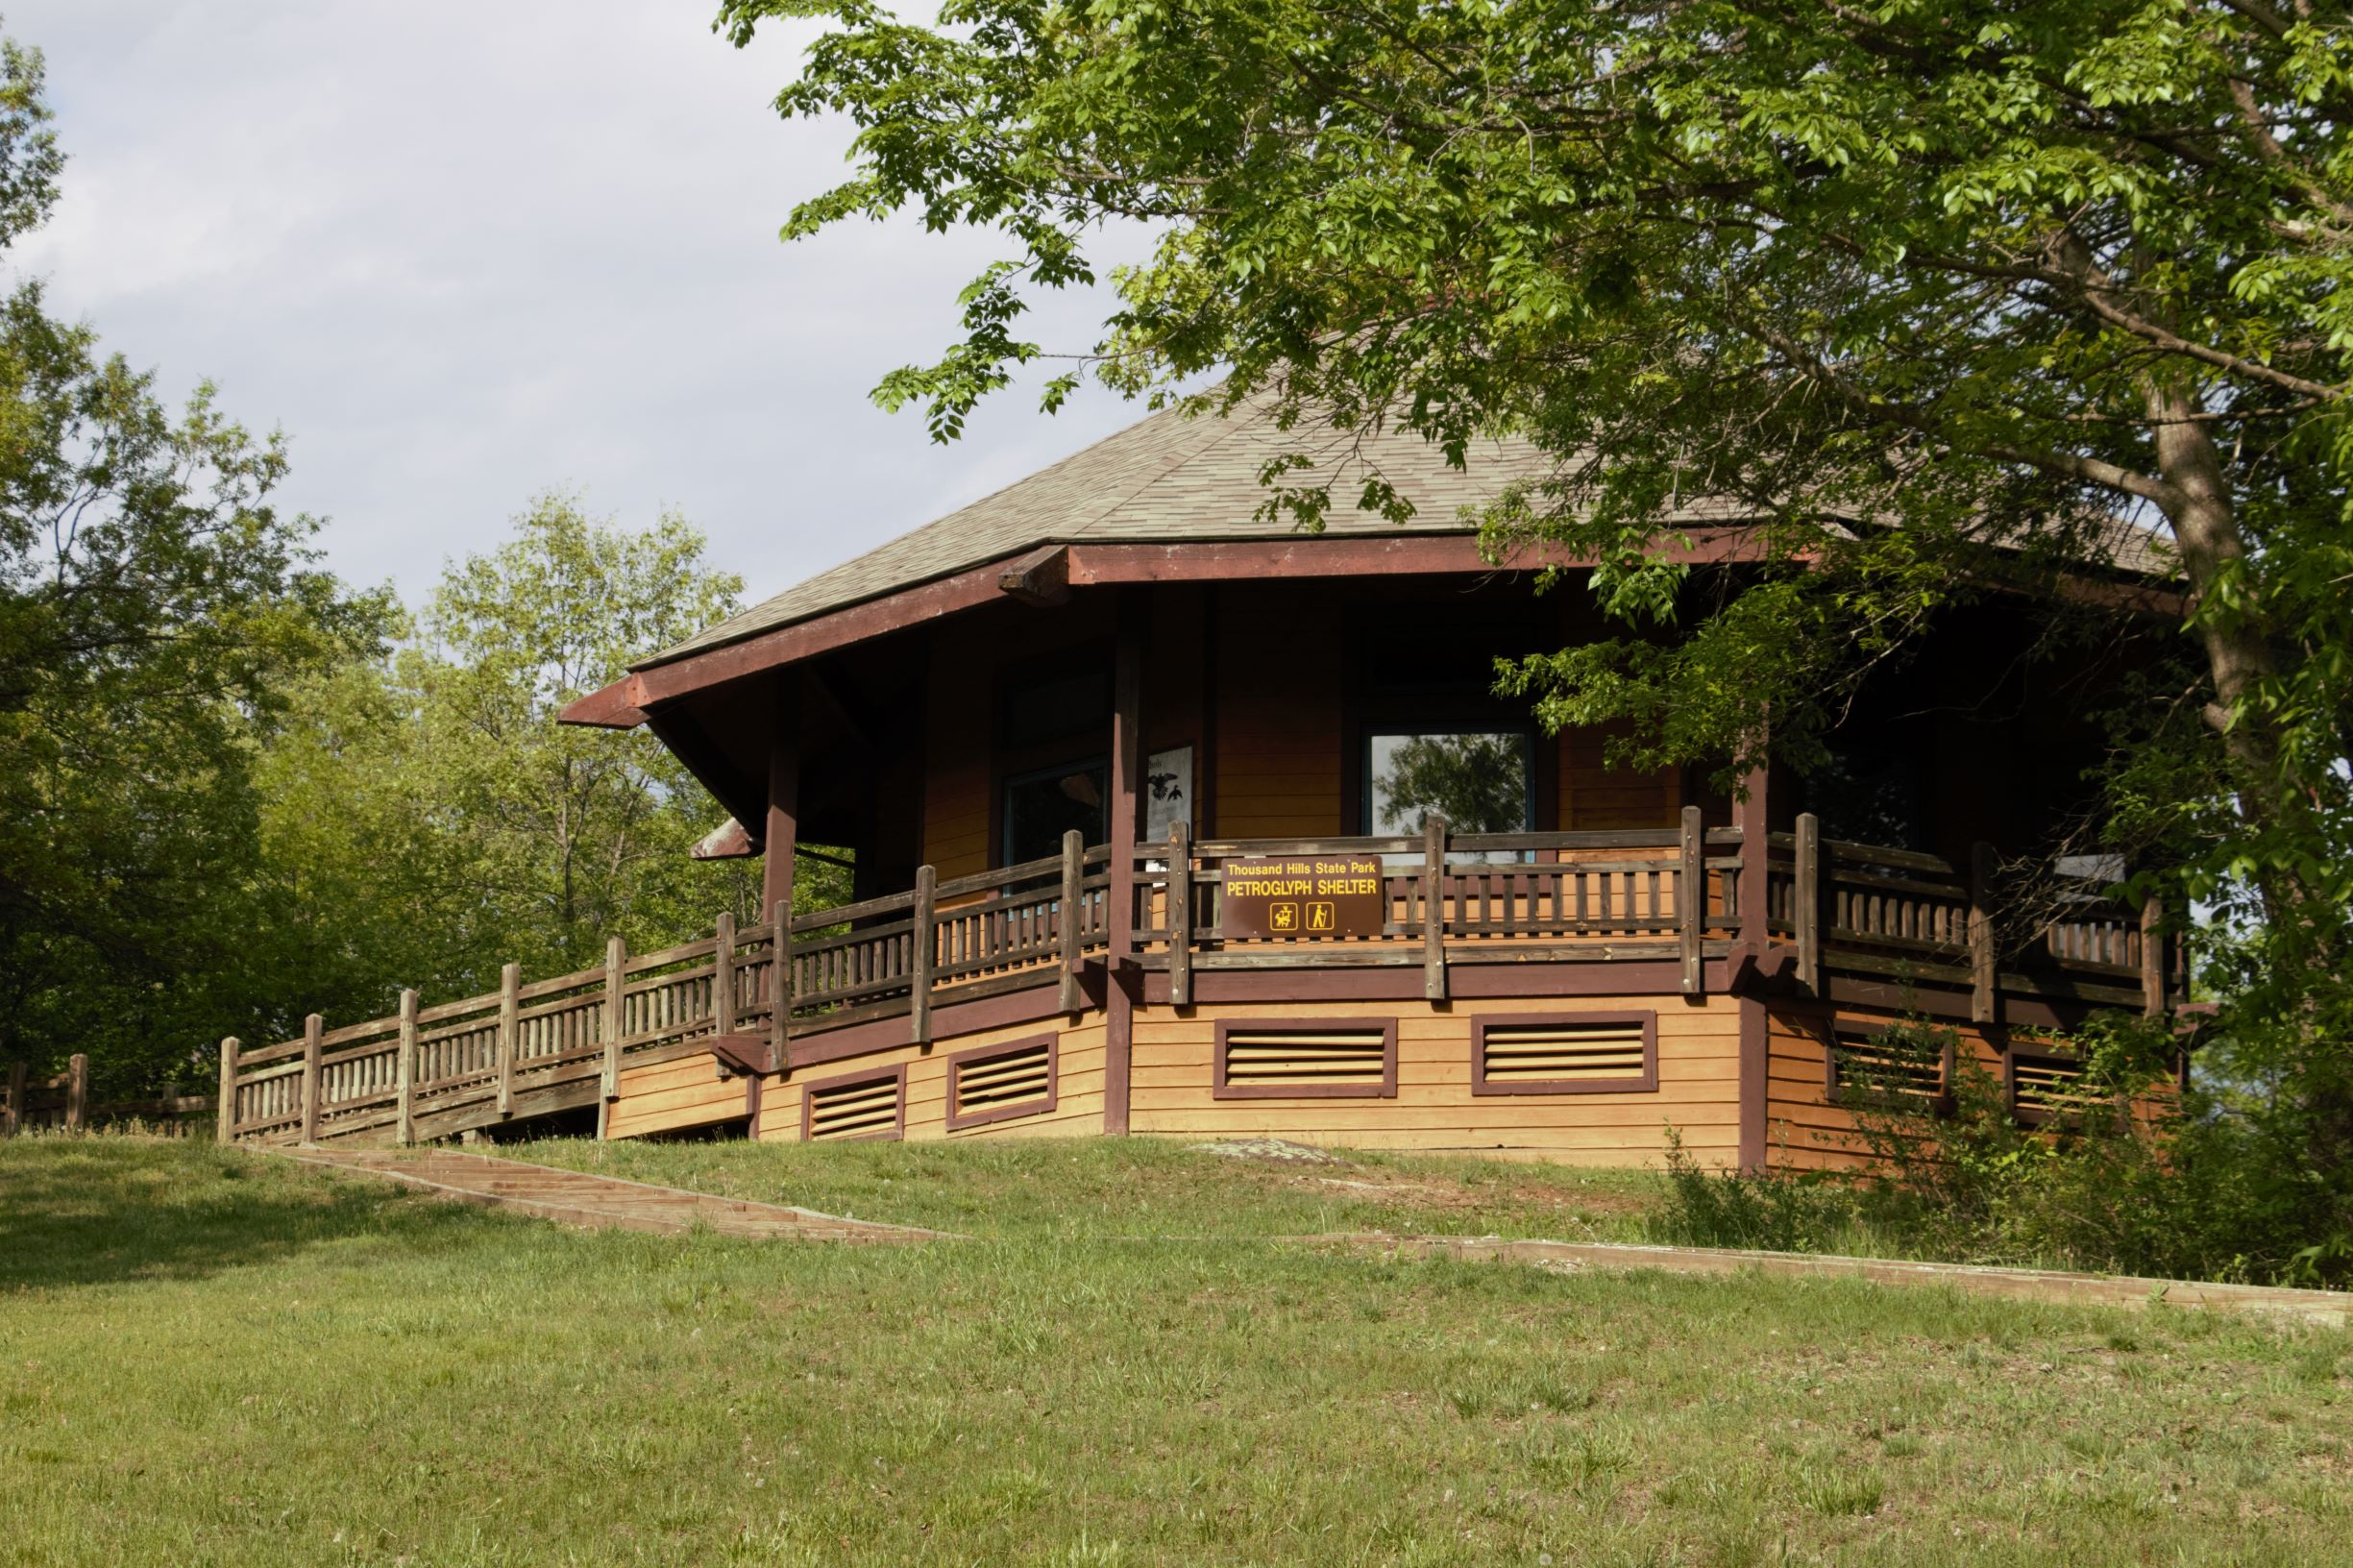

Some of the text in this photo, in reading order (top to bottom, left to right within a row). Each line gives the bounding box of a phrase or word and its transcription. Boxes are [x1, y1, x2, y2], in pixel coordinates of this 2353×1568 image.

[1228, 861, 1376, 875] Thousand Hills State Park
[1227, 878, 1376, 896] PETROGLYPH SHELTER
